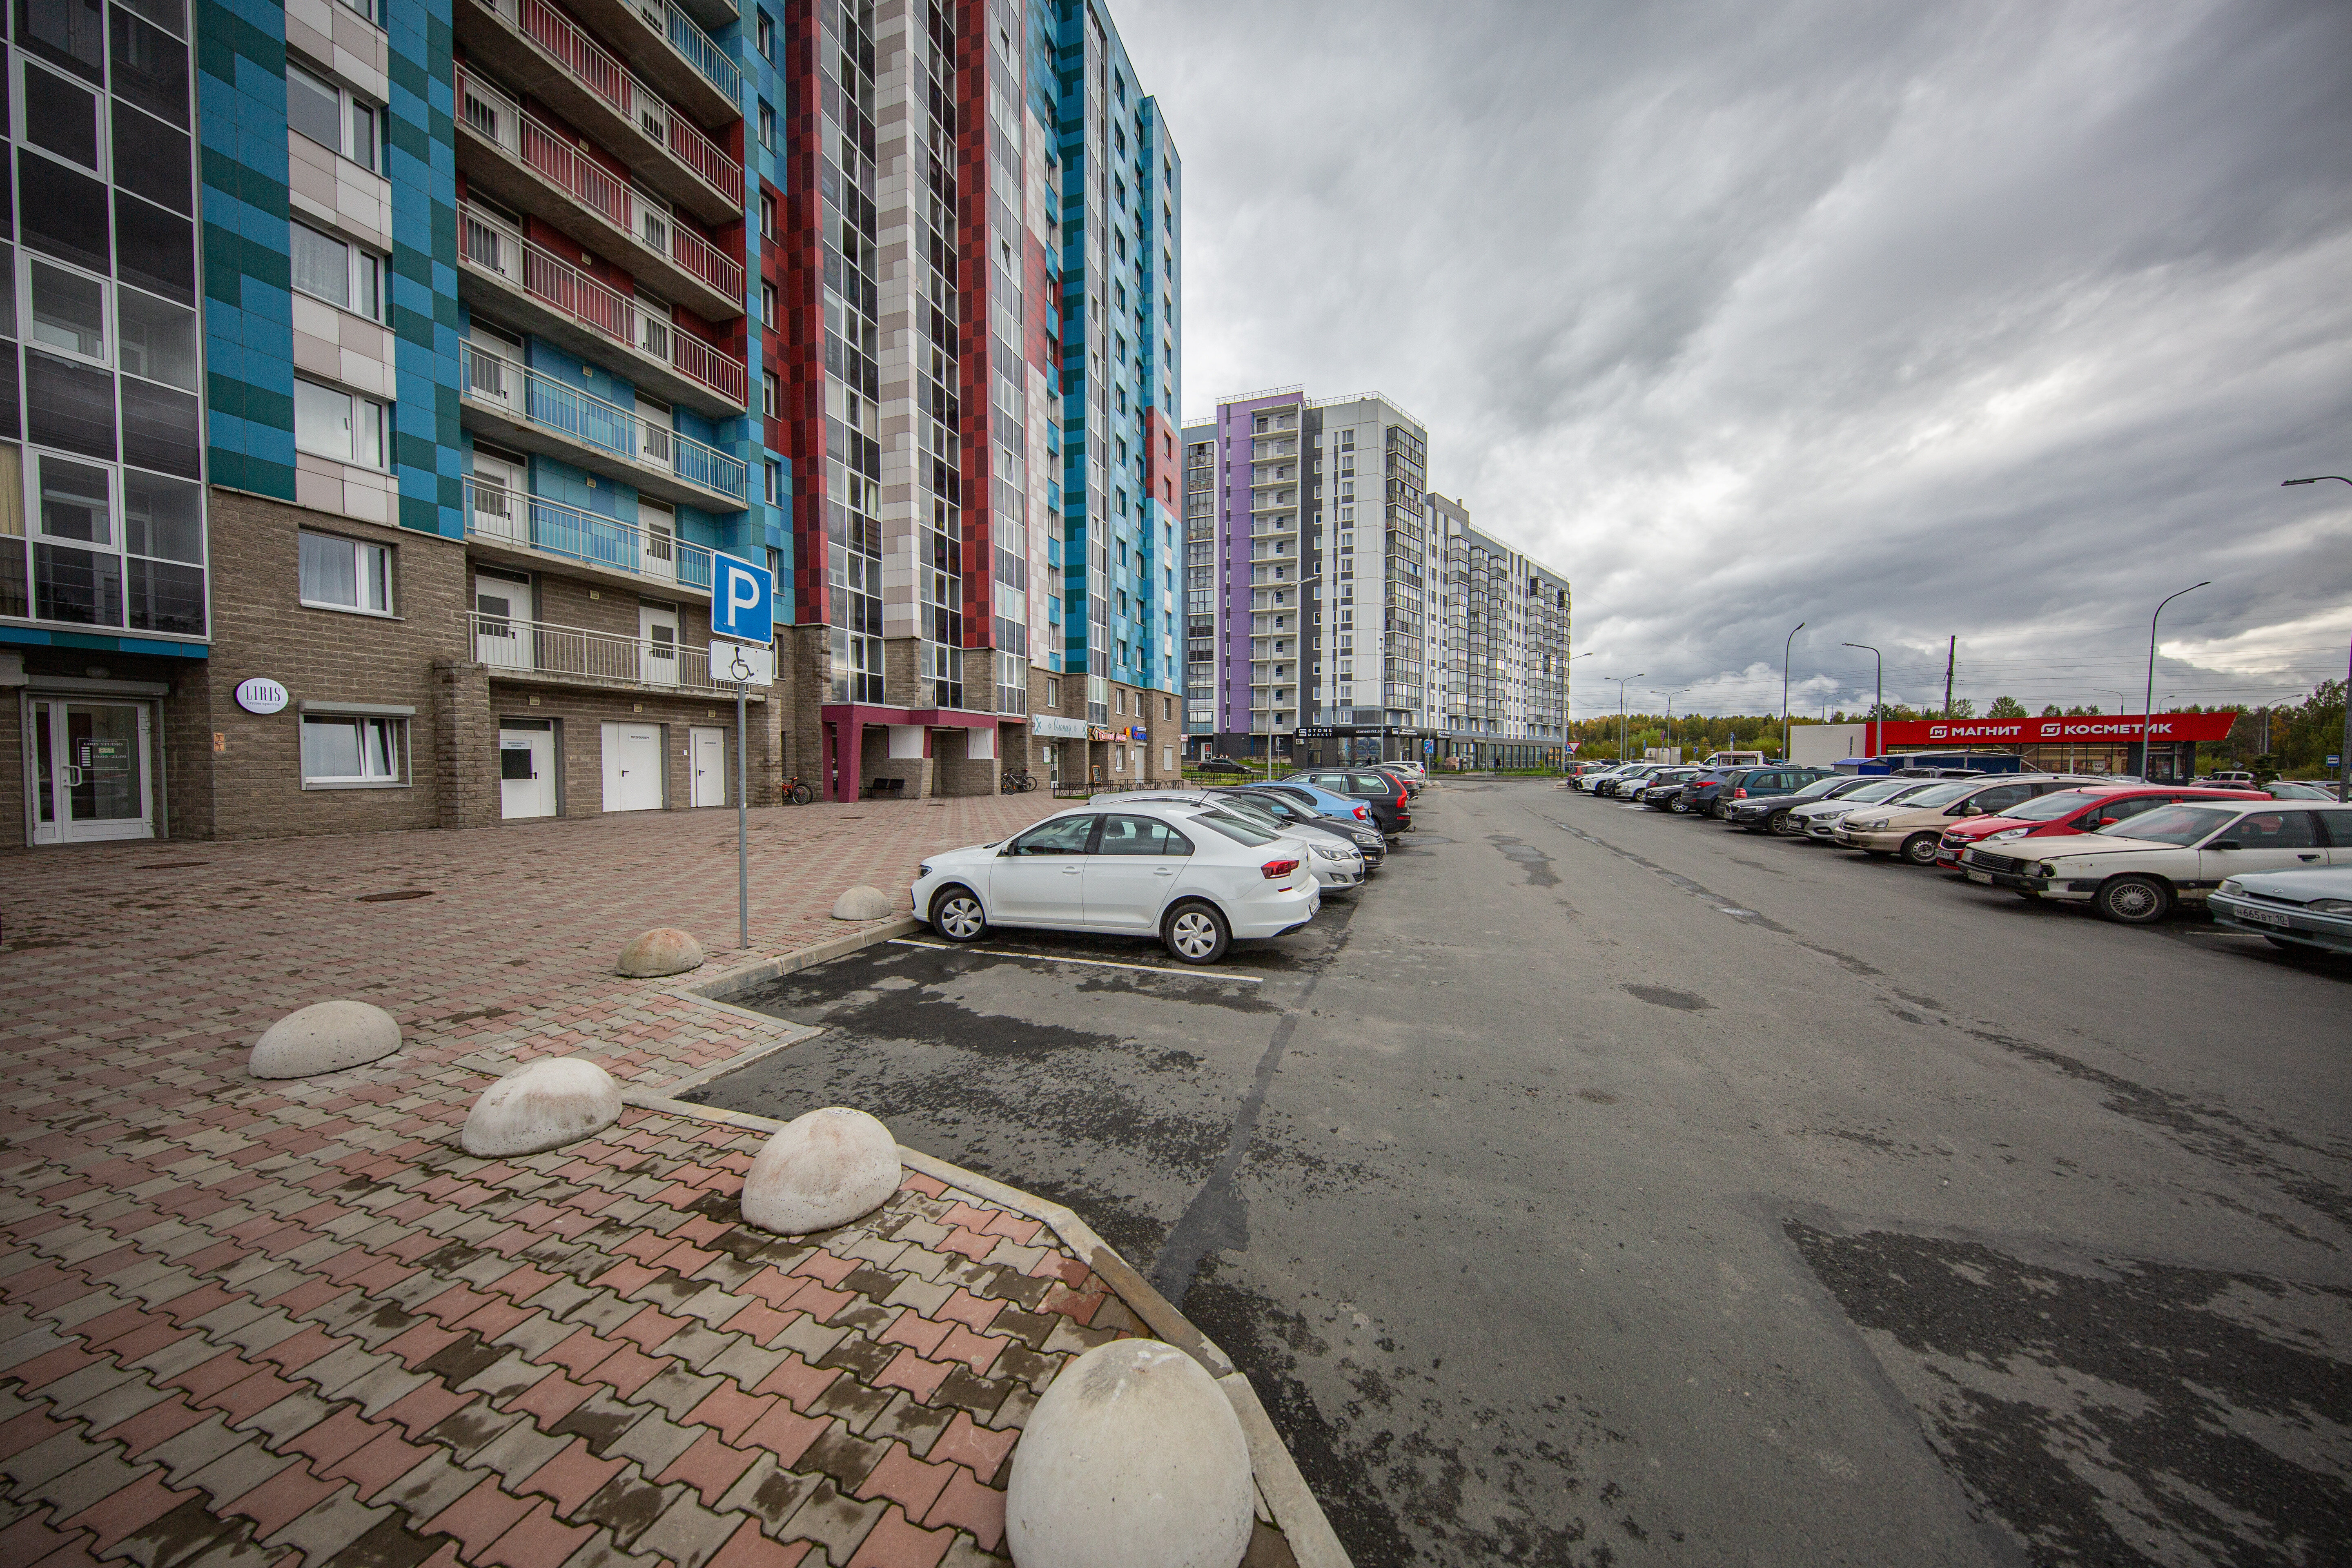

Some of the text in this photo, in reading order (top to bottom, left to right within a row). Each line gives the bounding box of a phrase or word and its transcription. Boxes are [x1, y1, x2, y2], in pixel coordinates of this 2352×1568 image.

[728, 566, 760, 626] P
[245, 686, 280, 701] LIRIS
[1952, 726, 2021, 736] МАГНИТ
[2065, 723, 2172, 734] КОСМЕТИК
[2236, 909, 2272, 922] Н665ВТ
